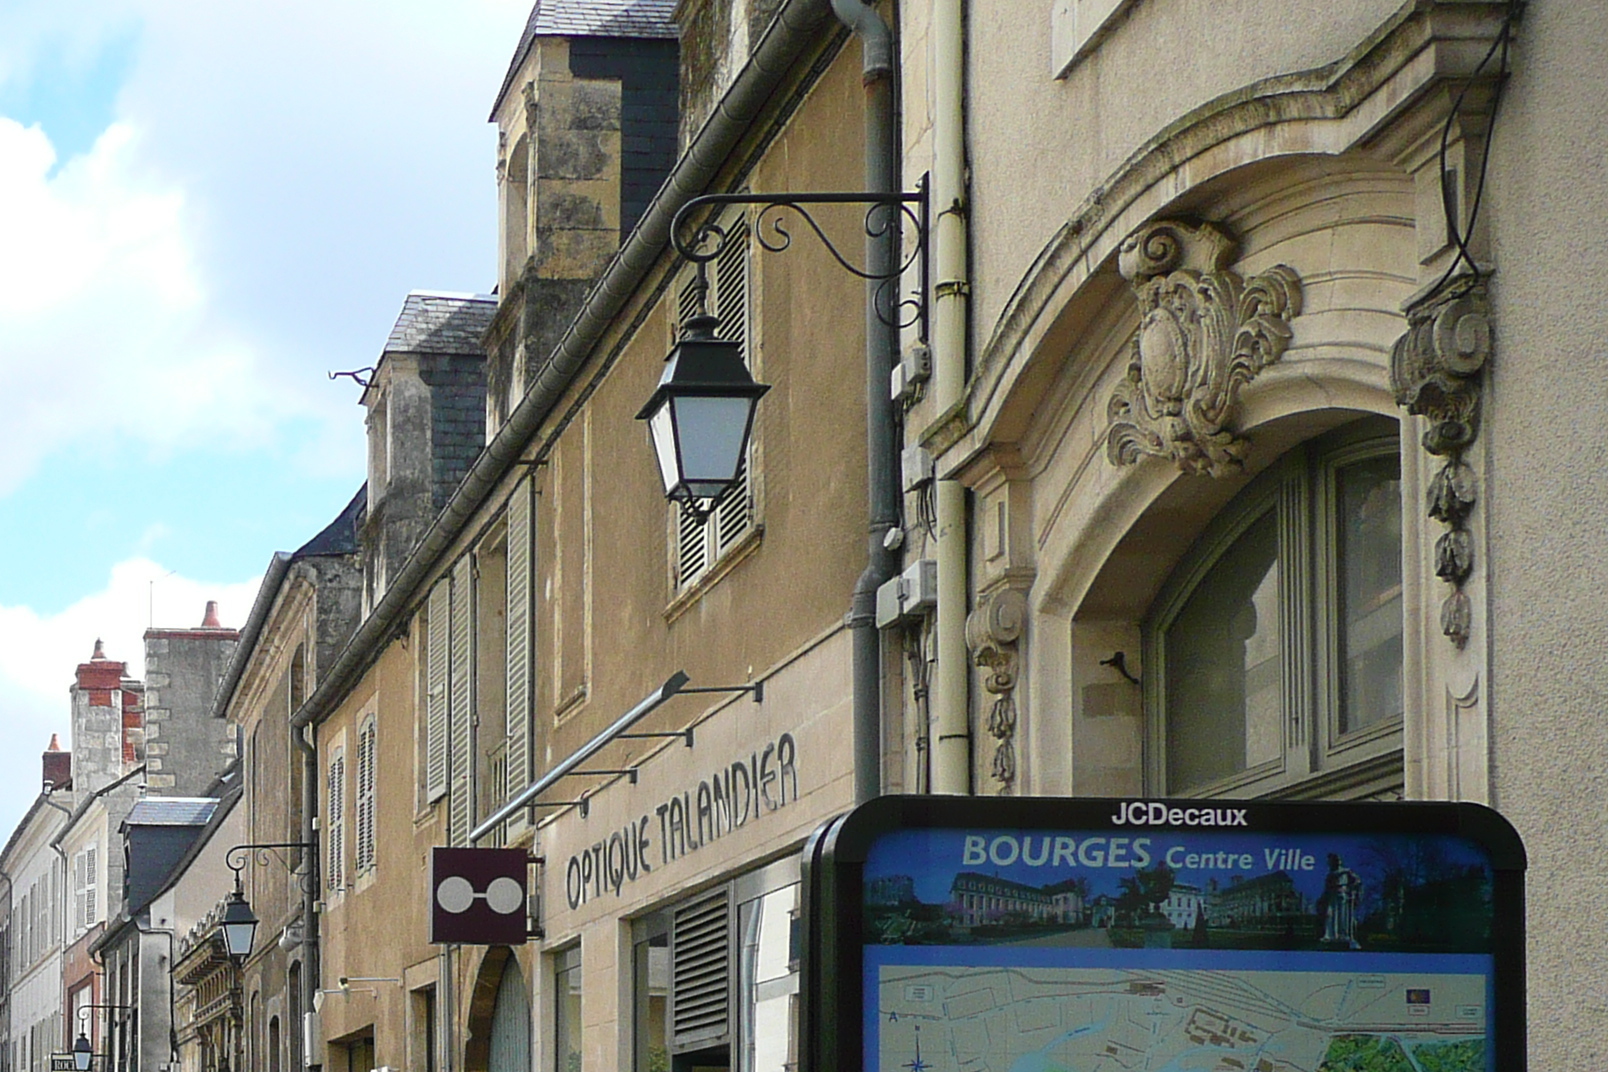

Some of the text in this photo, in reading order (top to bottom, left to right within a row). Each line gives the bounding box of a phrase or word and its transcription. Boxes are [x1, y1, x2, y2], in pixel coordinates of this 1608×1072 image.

[566, 732, 798, 911] OPTIQUE TALANDIER
[1111, 802, 1247, 827] JCDecaux
[961, 835, 1315, 871] BOURGES Centre Ville
[888, 1012, 898, 1022] A
